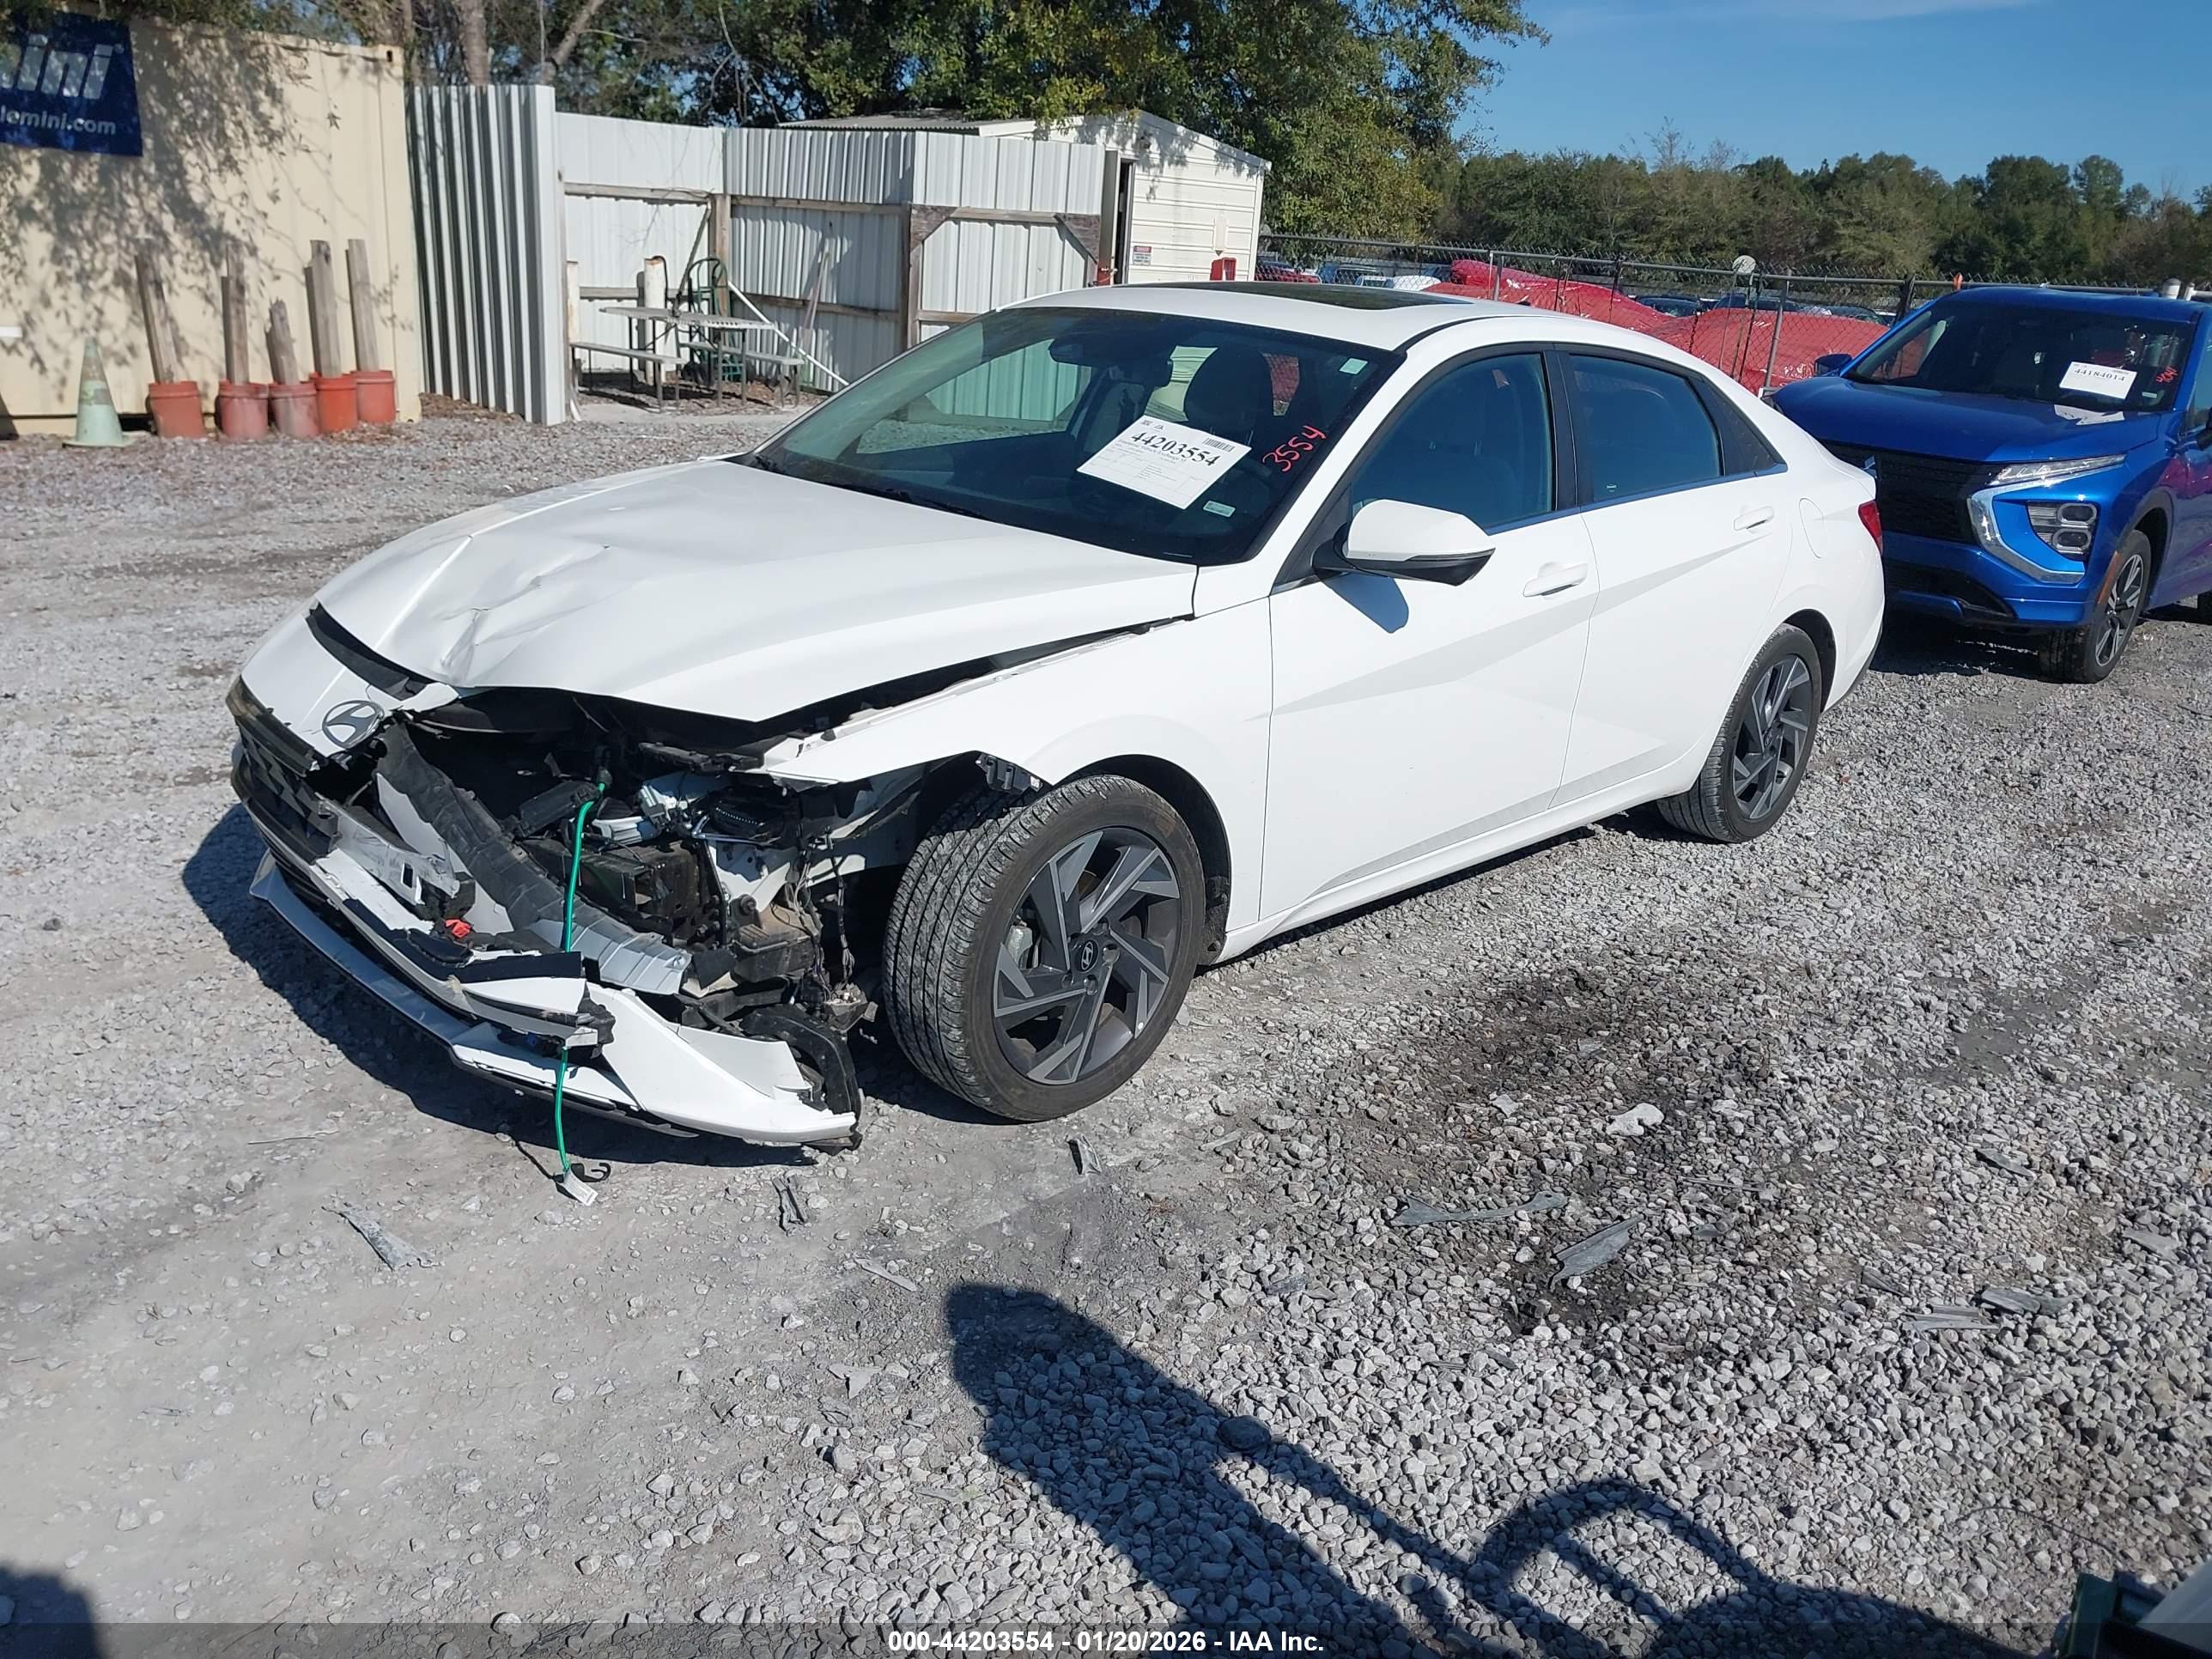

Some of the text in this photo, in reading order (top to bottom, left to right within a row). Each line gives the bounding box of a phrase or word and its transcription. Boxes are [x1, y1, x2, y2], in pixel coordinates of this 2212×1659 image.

[2074, 368, 2125, 382] 44184014
[1131, 432, 1222, 466] 44203554
[1262, 425, 1327, 472] 3554
